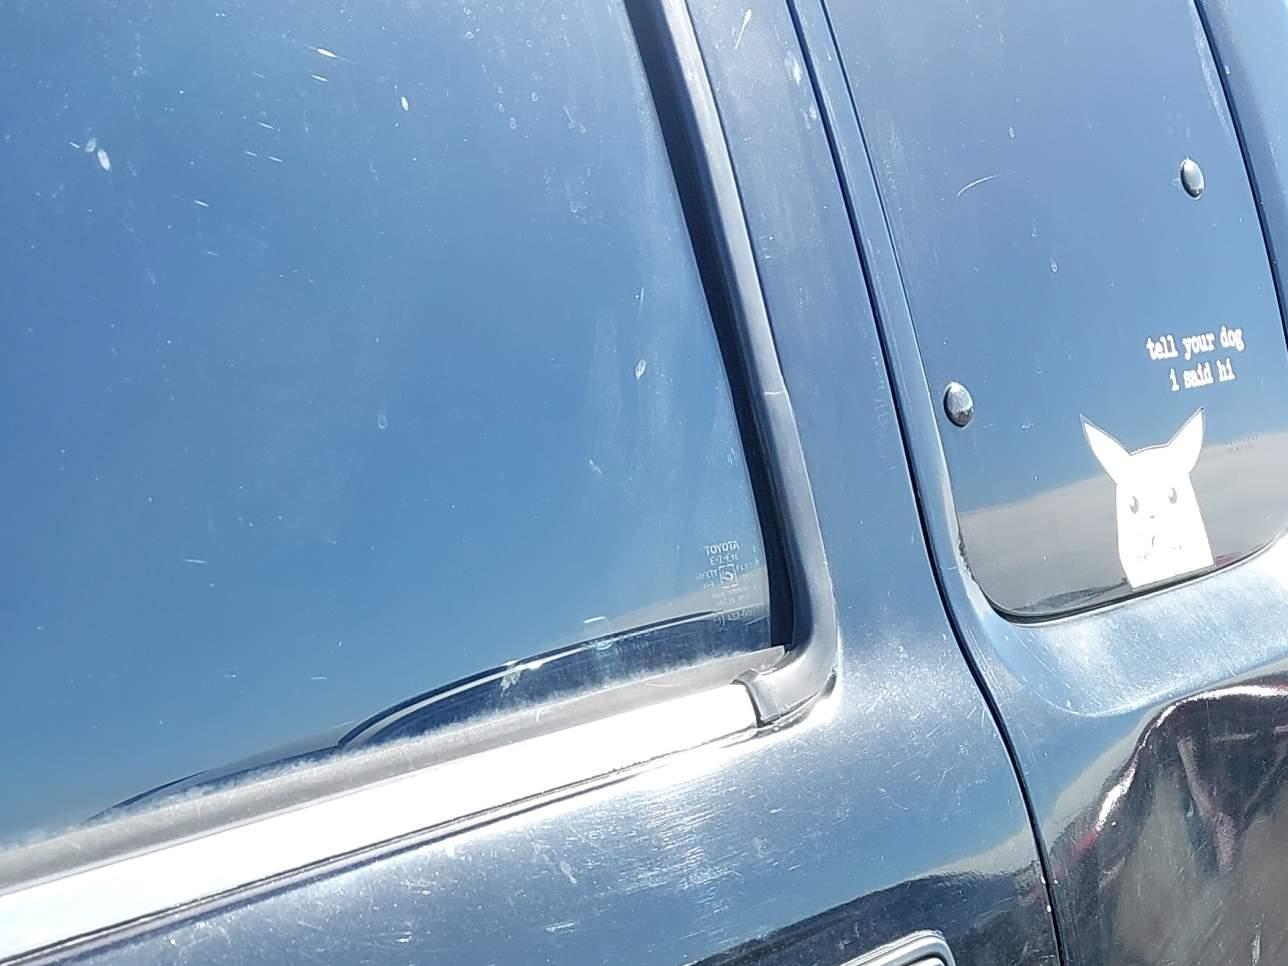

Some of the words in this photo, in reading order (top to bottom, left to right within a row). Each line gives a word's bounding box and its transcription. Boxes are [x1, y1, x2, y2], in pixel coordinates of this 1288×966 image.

[1146, 336, 1178, 360] tell
[1182, 333, 1215, 360] your
[1219, 325, 1245, 351] dog
[1183, 361, 1214, 388] said
[1216, 357, 1235, 381] hi
[703, 540, 740, 556] TOYOTA
